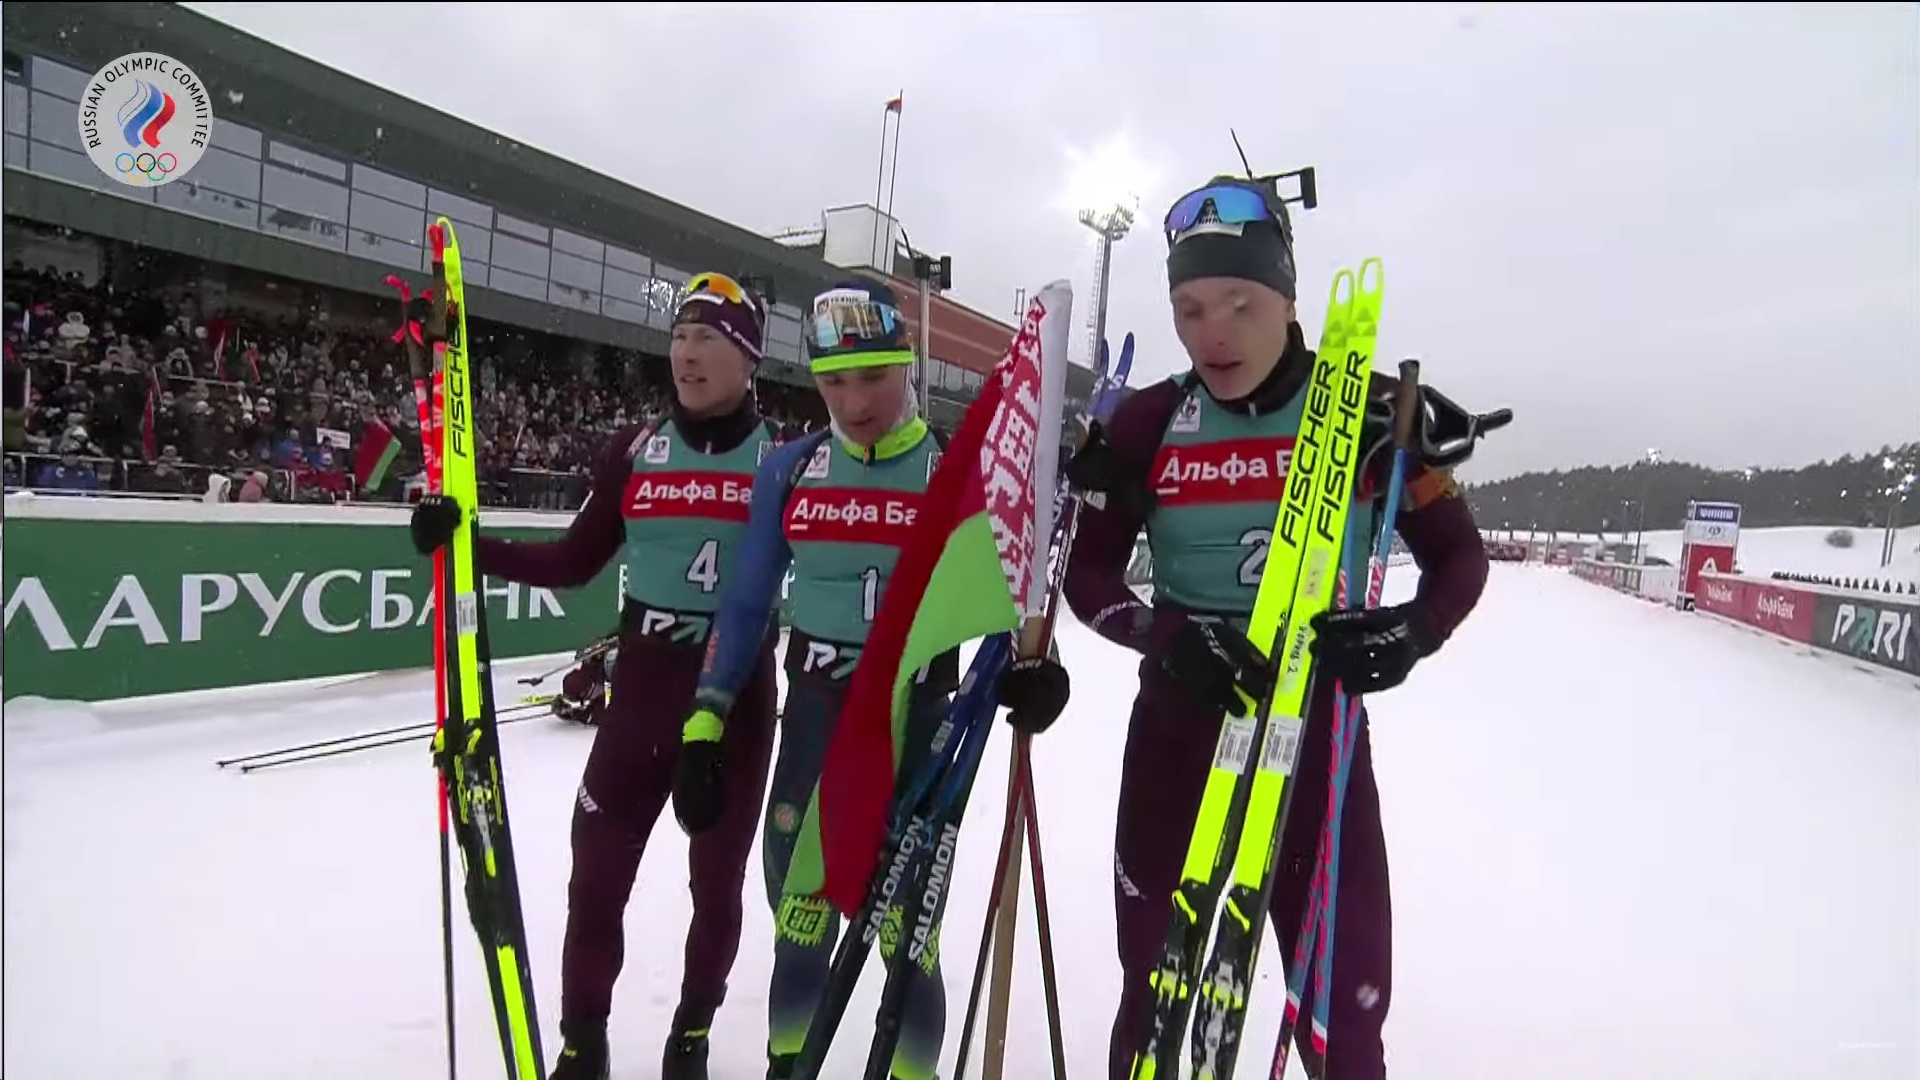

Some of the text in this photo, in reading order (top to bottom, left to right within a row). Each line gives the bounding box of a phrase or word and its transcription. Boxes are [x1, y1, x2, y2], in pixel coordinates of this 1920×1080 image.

[1158, 452, 1268, 486] Альфа
[1280, 360, 1337, 548] FISCHER
[1317, 350, 1367, 543] FISCHER
[633, 479, 716, 506] Альфа
[791, 497, 878, 526] Альфа
[686, 538, 720, 593] 4
[859, 566, 880, 622] 1
[1831, 604, 1911, 661] PARI
[862, 814, 925, 945] SALOMON
[908, 822, 958, 961] SALOMON
